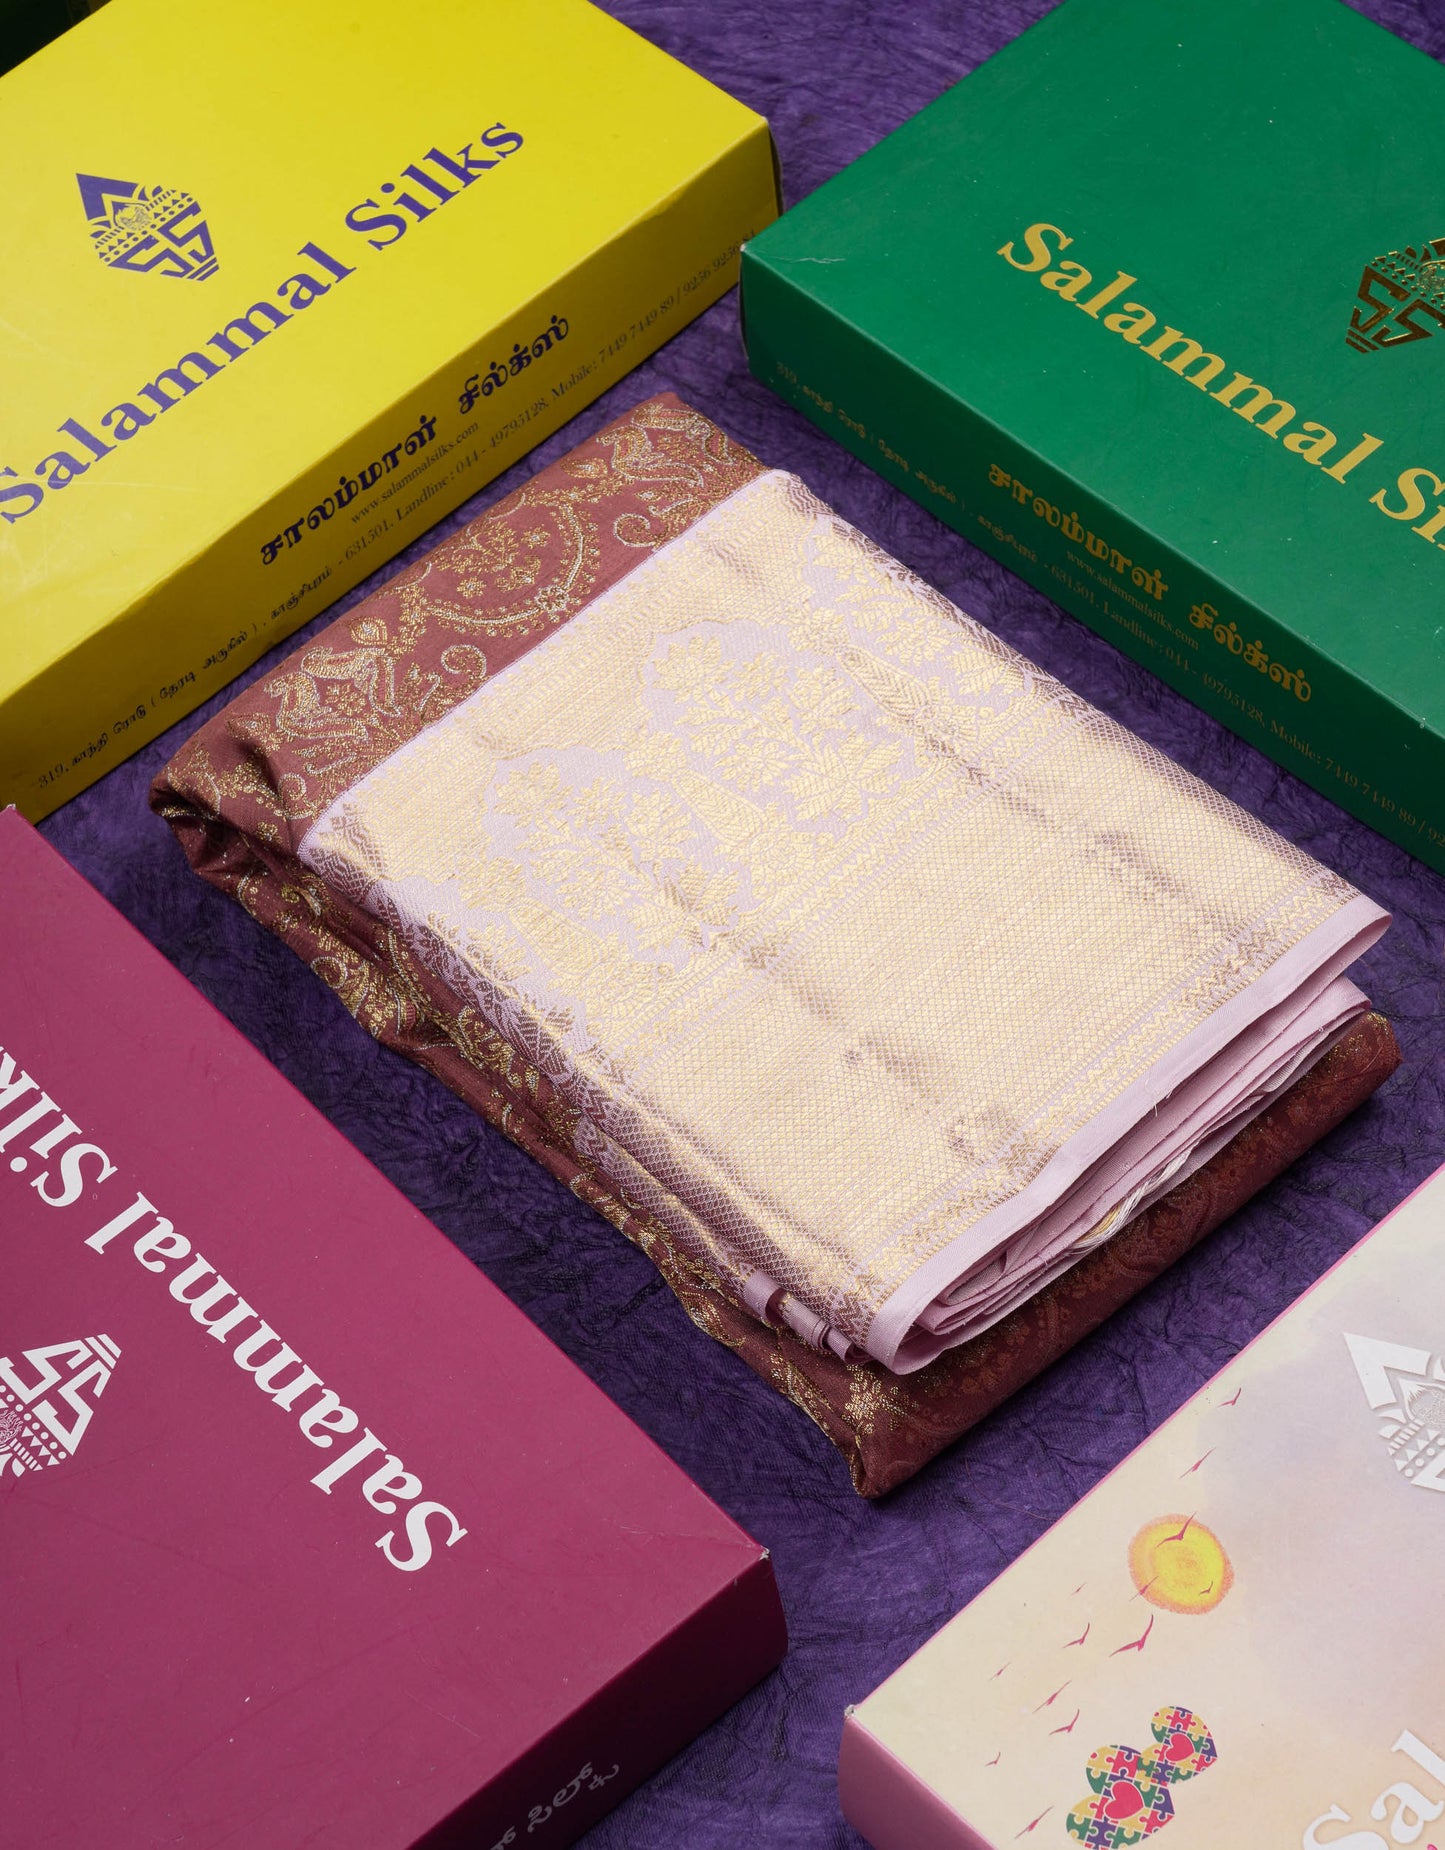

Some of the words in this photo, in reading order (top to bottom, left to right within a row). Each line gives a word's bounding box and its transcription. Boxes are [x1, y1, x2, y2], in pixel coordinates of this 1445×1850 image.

[0, 242, 357, 524] Salammal
[345, 121, 524, 251] Silks
[260, 414, 437, 565] சாலம்மாள்
[458, 315, 569, 414] சில்க்ஸ்
[551, 360, 597, 397] Mobile:
[996, 222, 1384, 485] Salammal
[351, 421, 479, 523] www.salammalsilks.com
[989, 463, 1168, 600] சாலம்மாள்
[1187, 602, 1312, 701] சில்க்ஸ்
[1066, 549, 1199, 652] www.salammalsilks.com
[0, 1046, 118, 1207] Silk
[84, 1191, 468, 1572] Salammal
